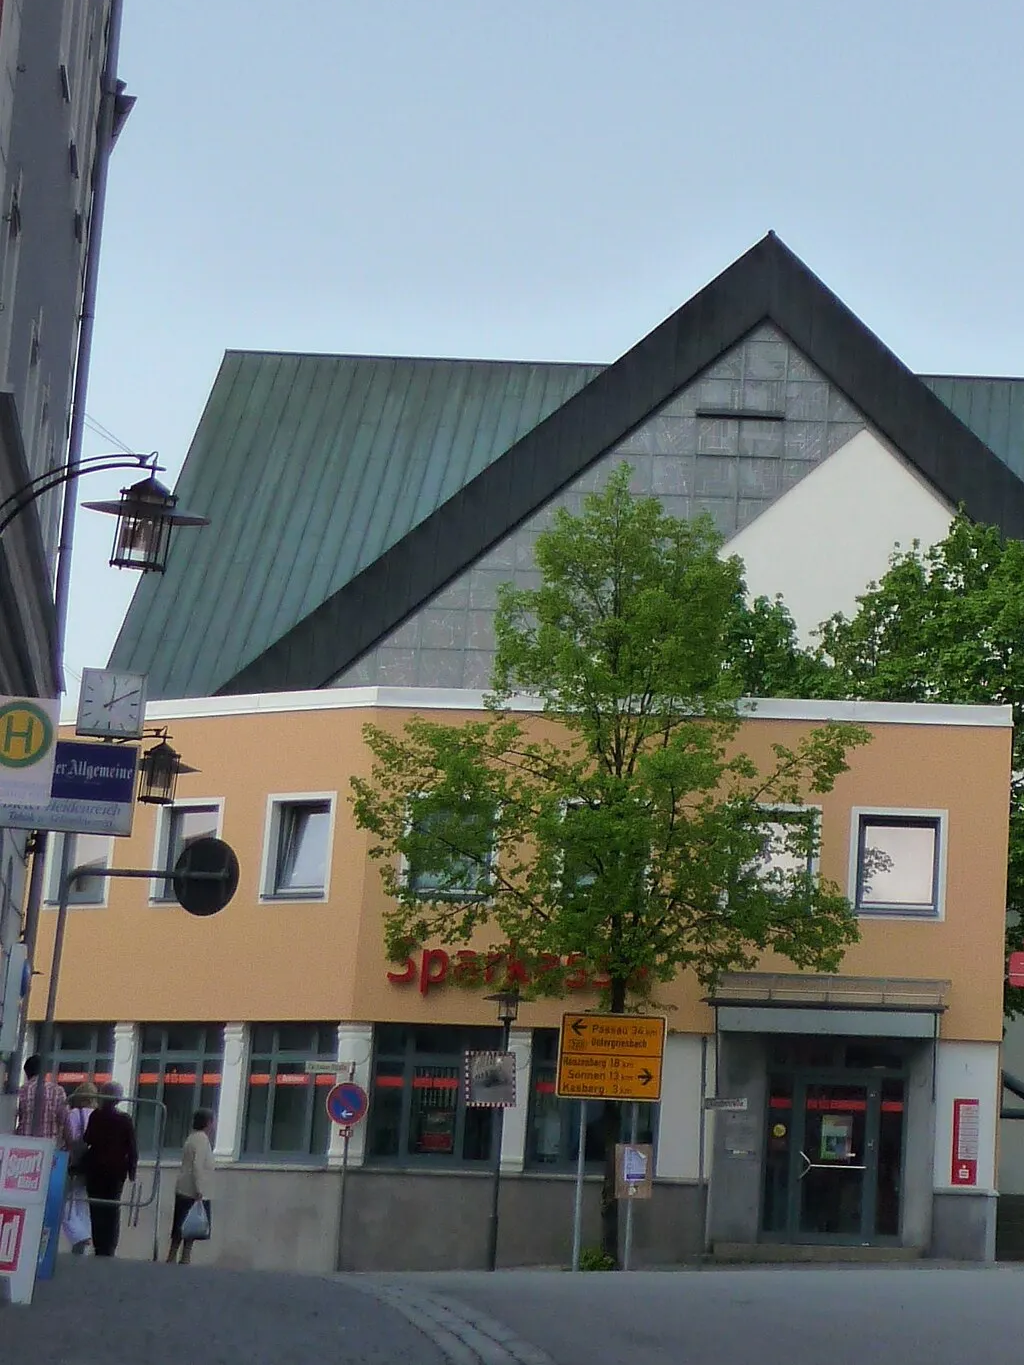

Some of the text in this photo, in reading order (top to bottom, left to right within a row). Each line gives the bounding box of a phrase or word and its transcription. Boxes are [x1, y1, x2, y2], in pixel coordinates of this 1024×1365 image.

[4, 715, 34, 754] H
[67, 758, 133, 780] Allgemeine
[592, 1024, 628, 1034] Passau
[567, 1069, 606, 1080] Sonnen
